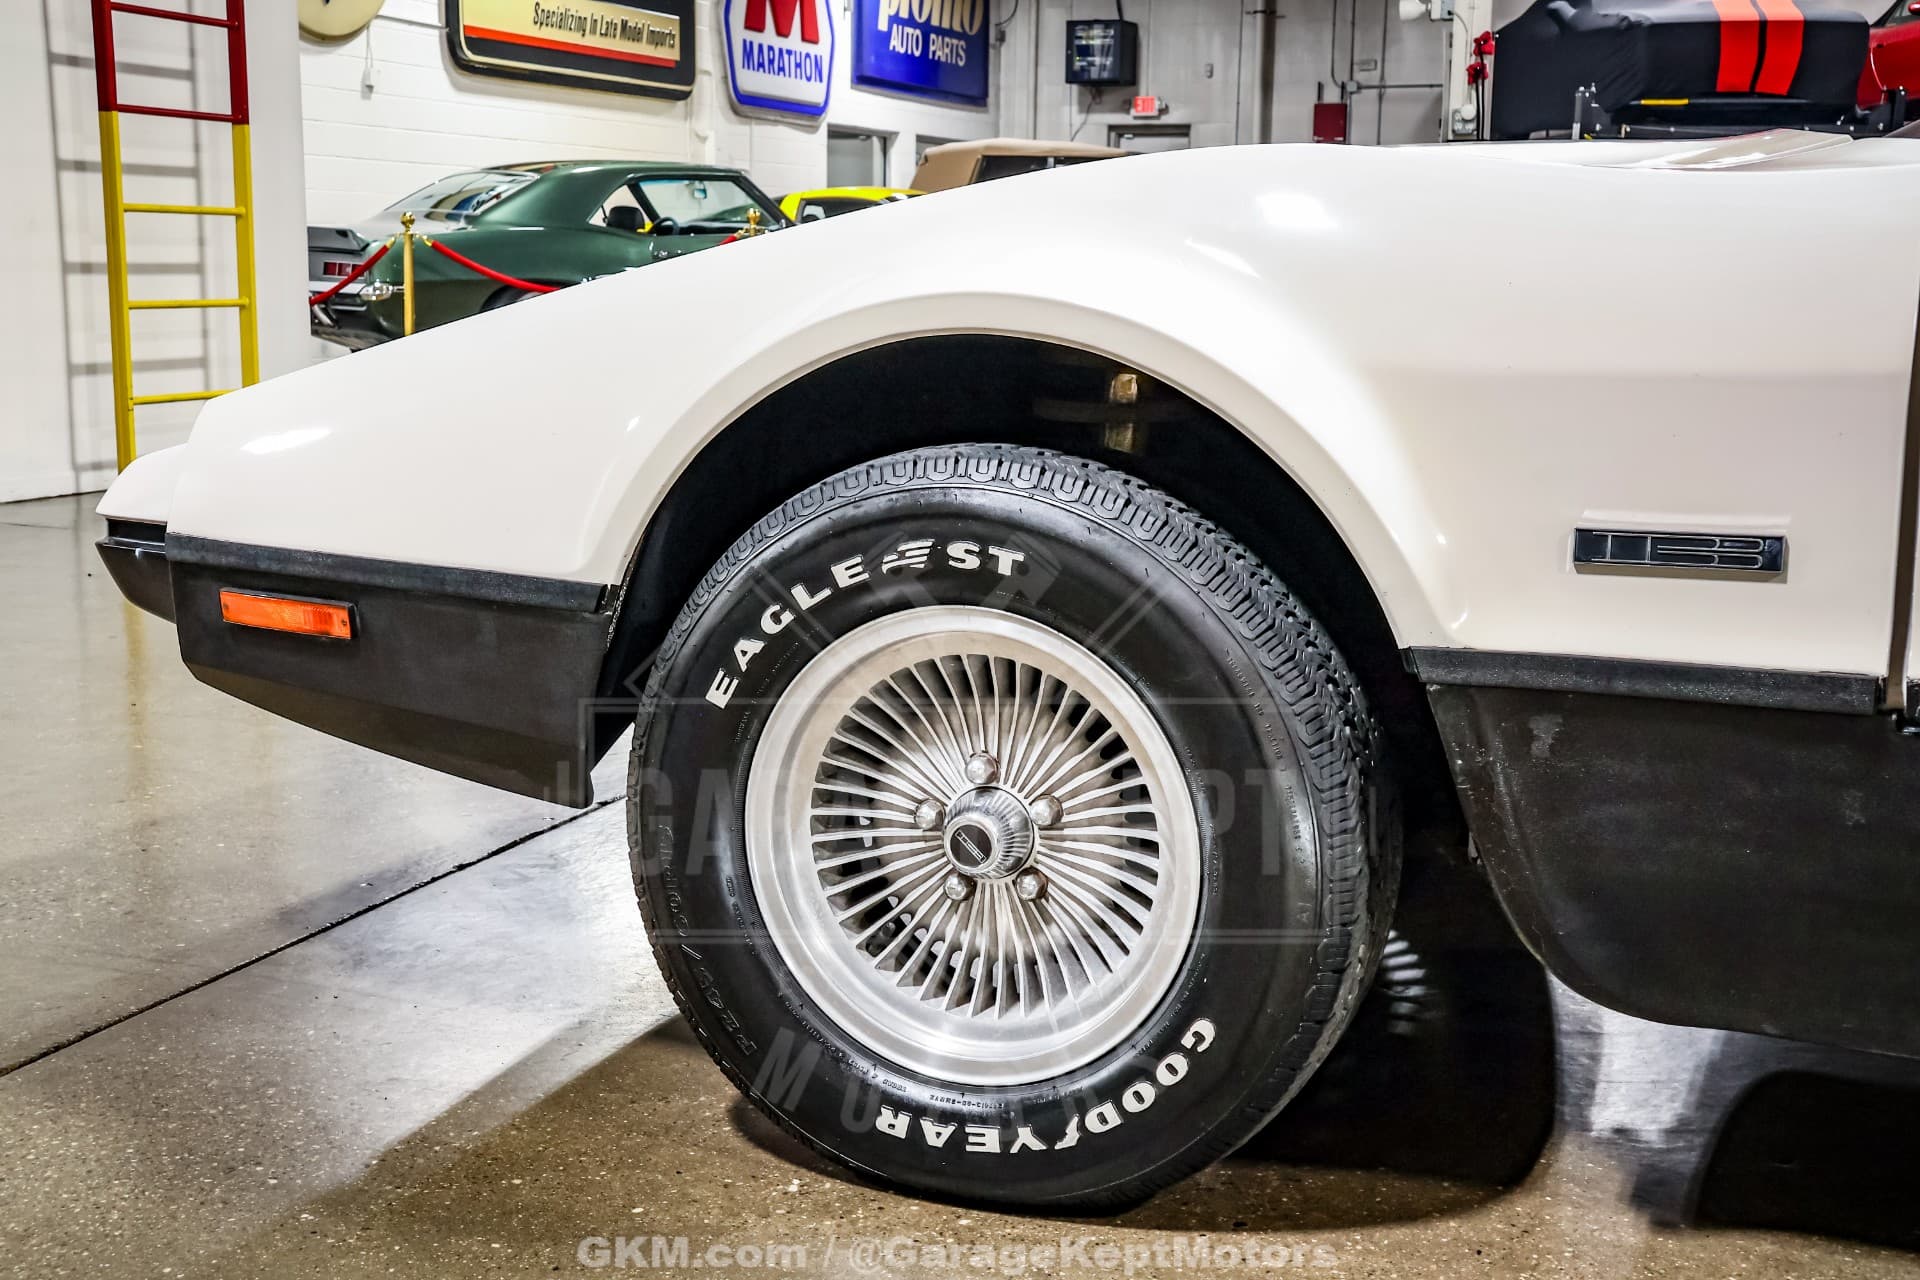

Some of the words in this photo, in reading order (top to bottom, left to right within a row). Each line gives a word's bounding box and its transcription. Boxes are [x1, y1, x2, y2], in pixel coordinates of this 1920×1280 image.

[533, 1, 588, 38] Specializing
[589, 12, 598, 36] In
[600, 14, 618, 39] Late
[620, 17, 645, 42] Model
[646, 22, 676, 49] Imports
[889, 23, 922, 57] AUTO
[928, 33, 966, 67] PARTS
[742, 38, 823, 83] MARATHON
[704, 554, 871, 710] EAGLE
[946, 540, 1026, 577] ST
[874, 1016, 1217, 1155] GOODYEAR
